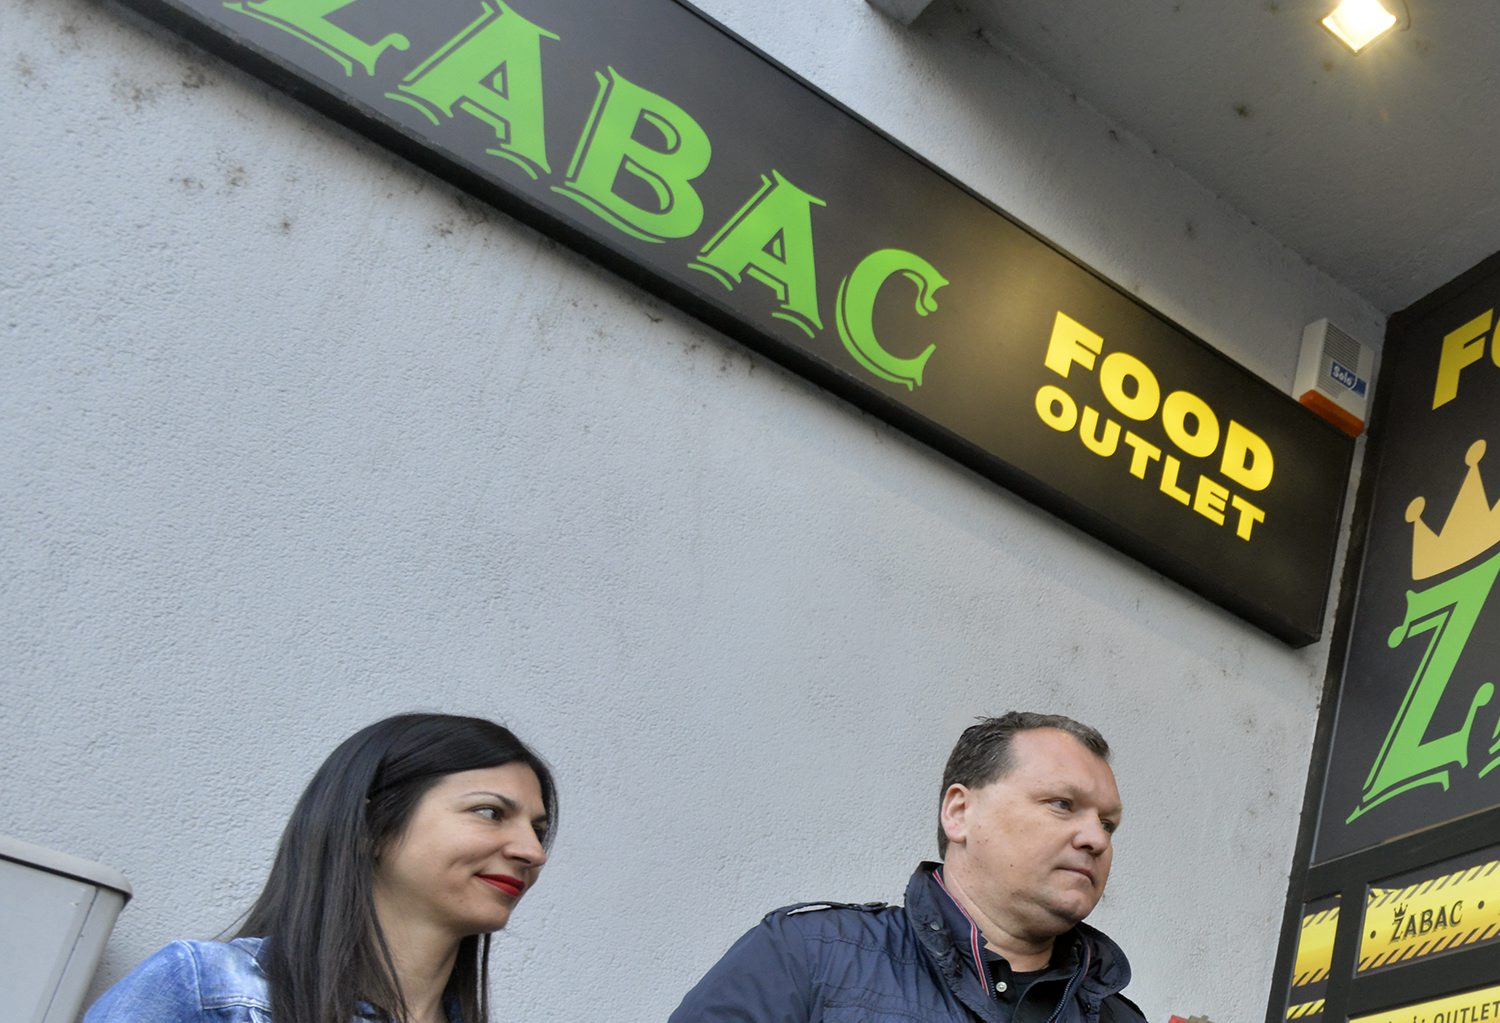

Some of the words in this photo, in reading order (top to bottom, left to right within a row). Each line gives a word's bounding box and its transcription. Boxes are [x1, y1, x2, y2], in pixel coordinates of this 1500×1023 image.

[1044, 310, 1274, 492] FOOD
[1331, 365, 1353, 387] Solo
[1035, 384, 1266, 542] OUTLET
